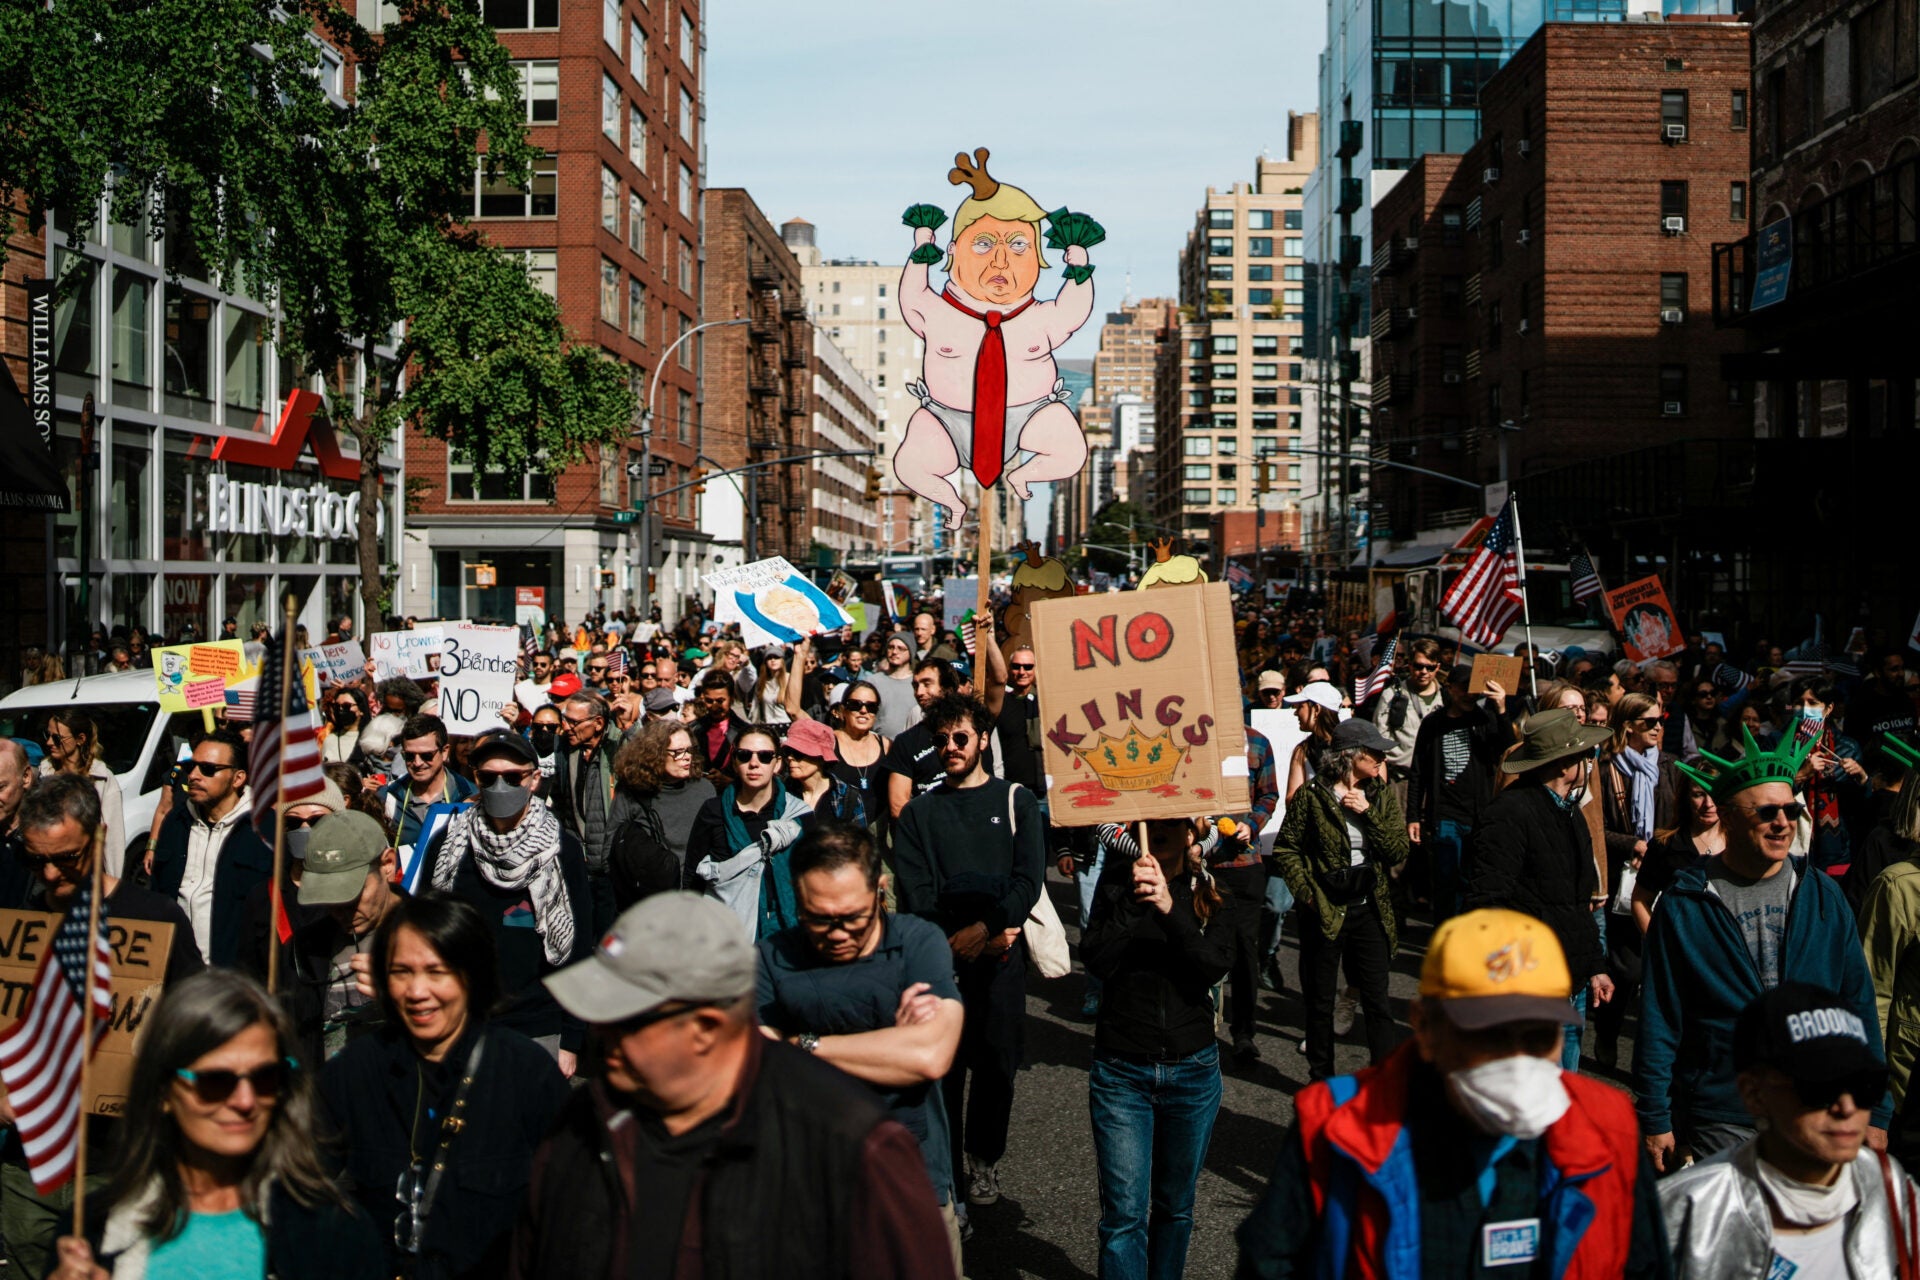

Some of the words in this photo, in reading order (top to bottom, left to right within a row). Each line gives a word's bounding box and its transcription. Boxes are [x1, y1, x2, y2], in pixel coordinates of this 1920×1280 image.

[33, 293, 49, 404] WILLIAMS
[209, 473, 308, 537] BLINDS
[163, 579, 200, 605] NOW
[322, 645, 348, 659] here
[441, 637, 461, 677] 3
[1070, 611, 1174, 670] NO
[441, 686, 481, 723] NO
[1047, 688, 1214, 756] KINGS
[1872, 721, 1890, 733] NO
[1736, 905, 1762, 925] The
